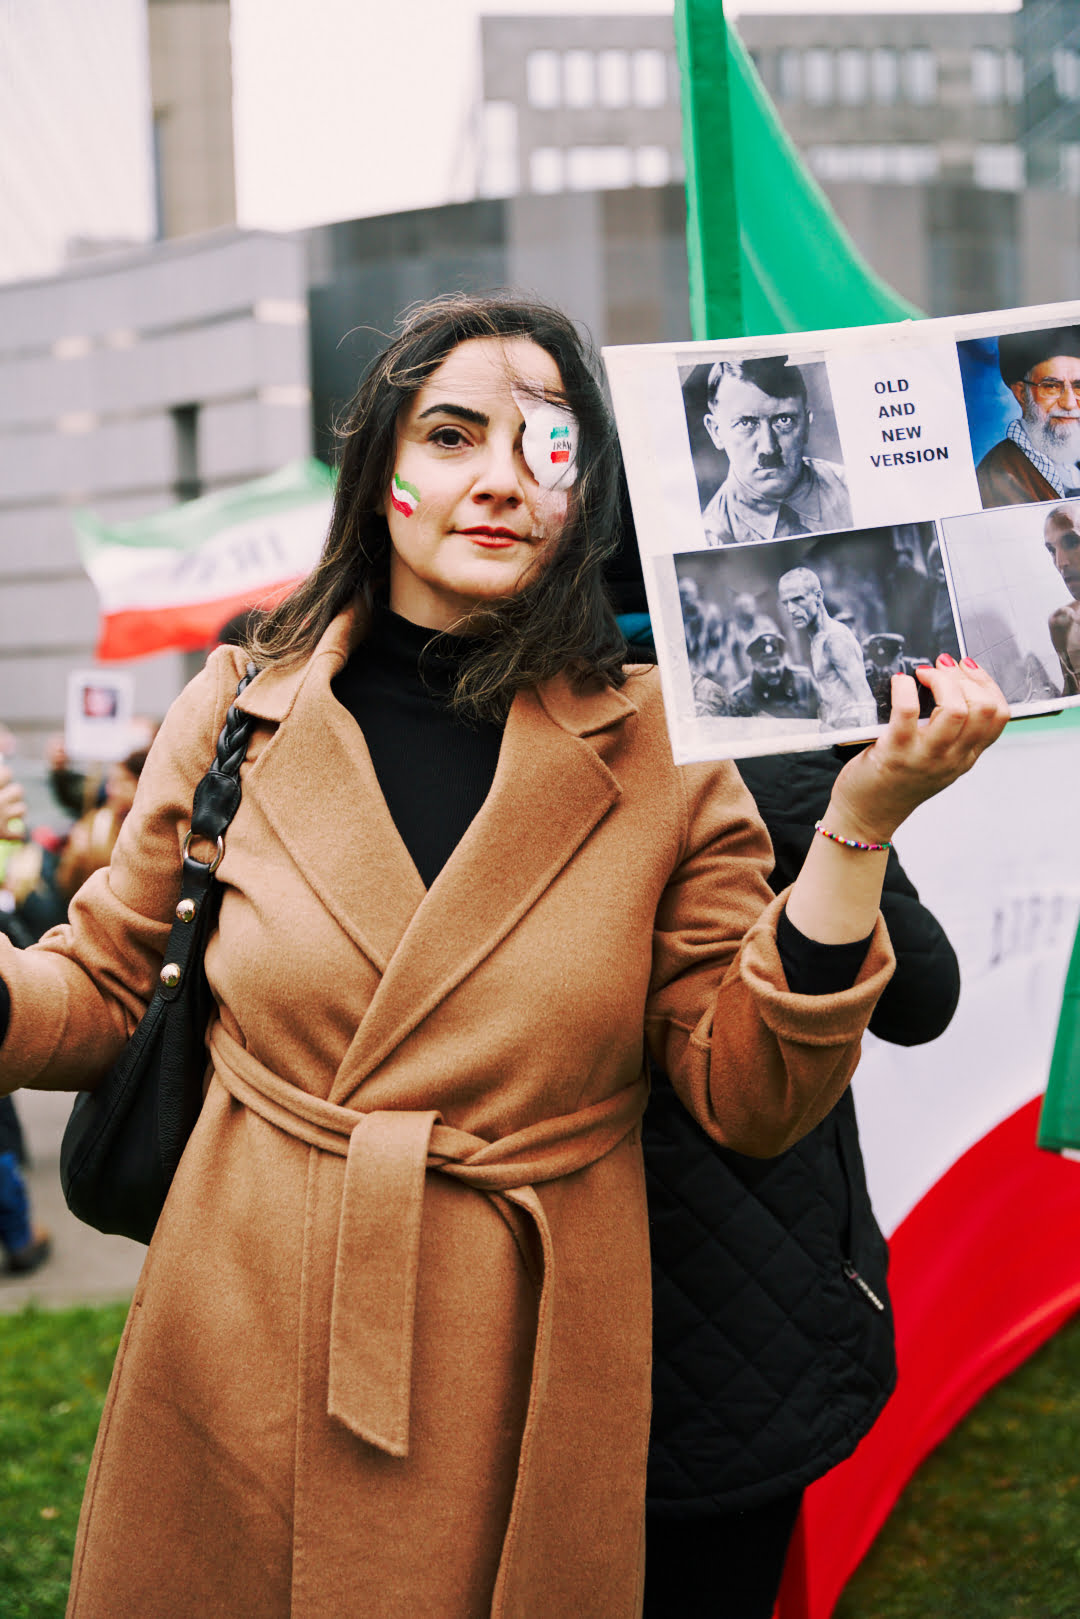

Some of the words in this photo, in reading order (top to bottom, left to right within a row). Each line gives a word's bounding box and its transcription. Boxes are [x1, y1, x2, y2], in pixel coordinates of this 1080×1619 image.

[874, 379, 909, 394] OLD
[878, 402, 915, 418] AND
[881, 425, 921, 442] NEW
[552, 440, 572, 451] IRAN
[870, 446, 949, 467] VERSION
